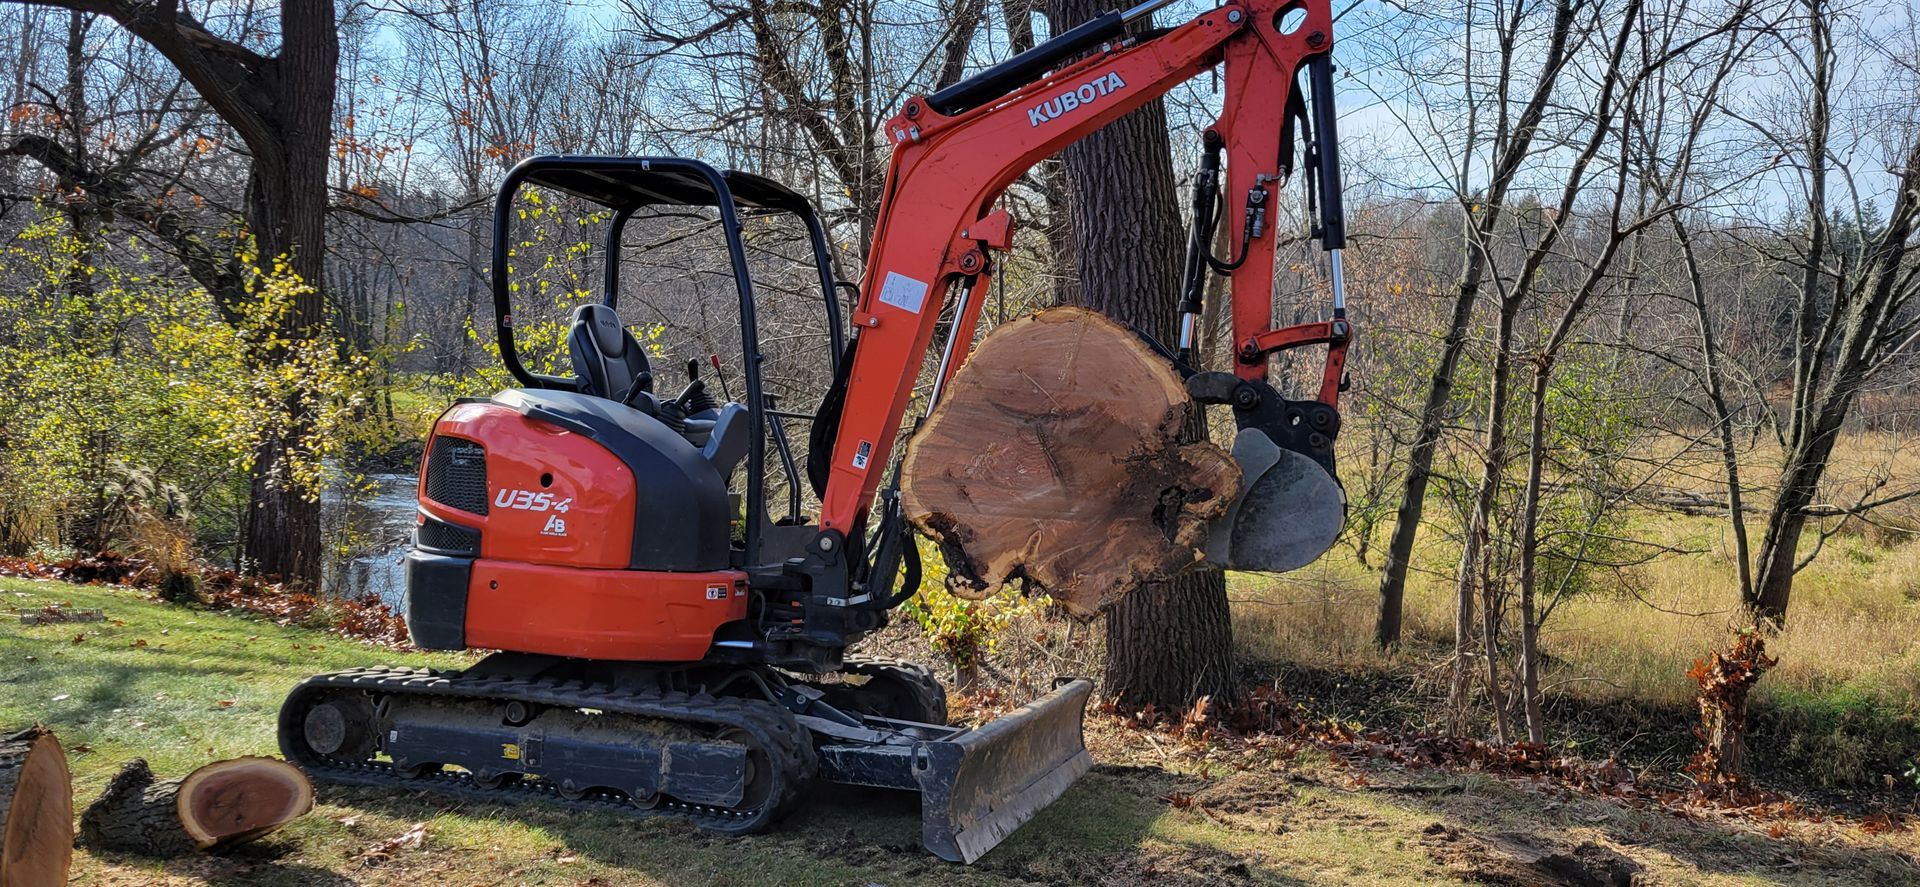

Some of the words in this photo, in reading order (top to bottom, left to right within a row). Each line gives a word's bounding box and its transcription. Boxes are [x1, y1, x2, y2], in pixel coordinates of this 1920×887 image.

[1027, 71, 1126, 127] KUBOTA
[494, 488, 573, 514] U35-4
[543, 514, 566, 533] AB
